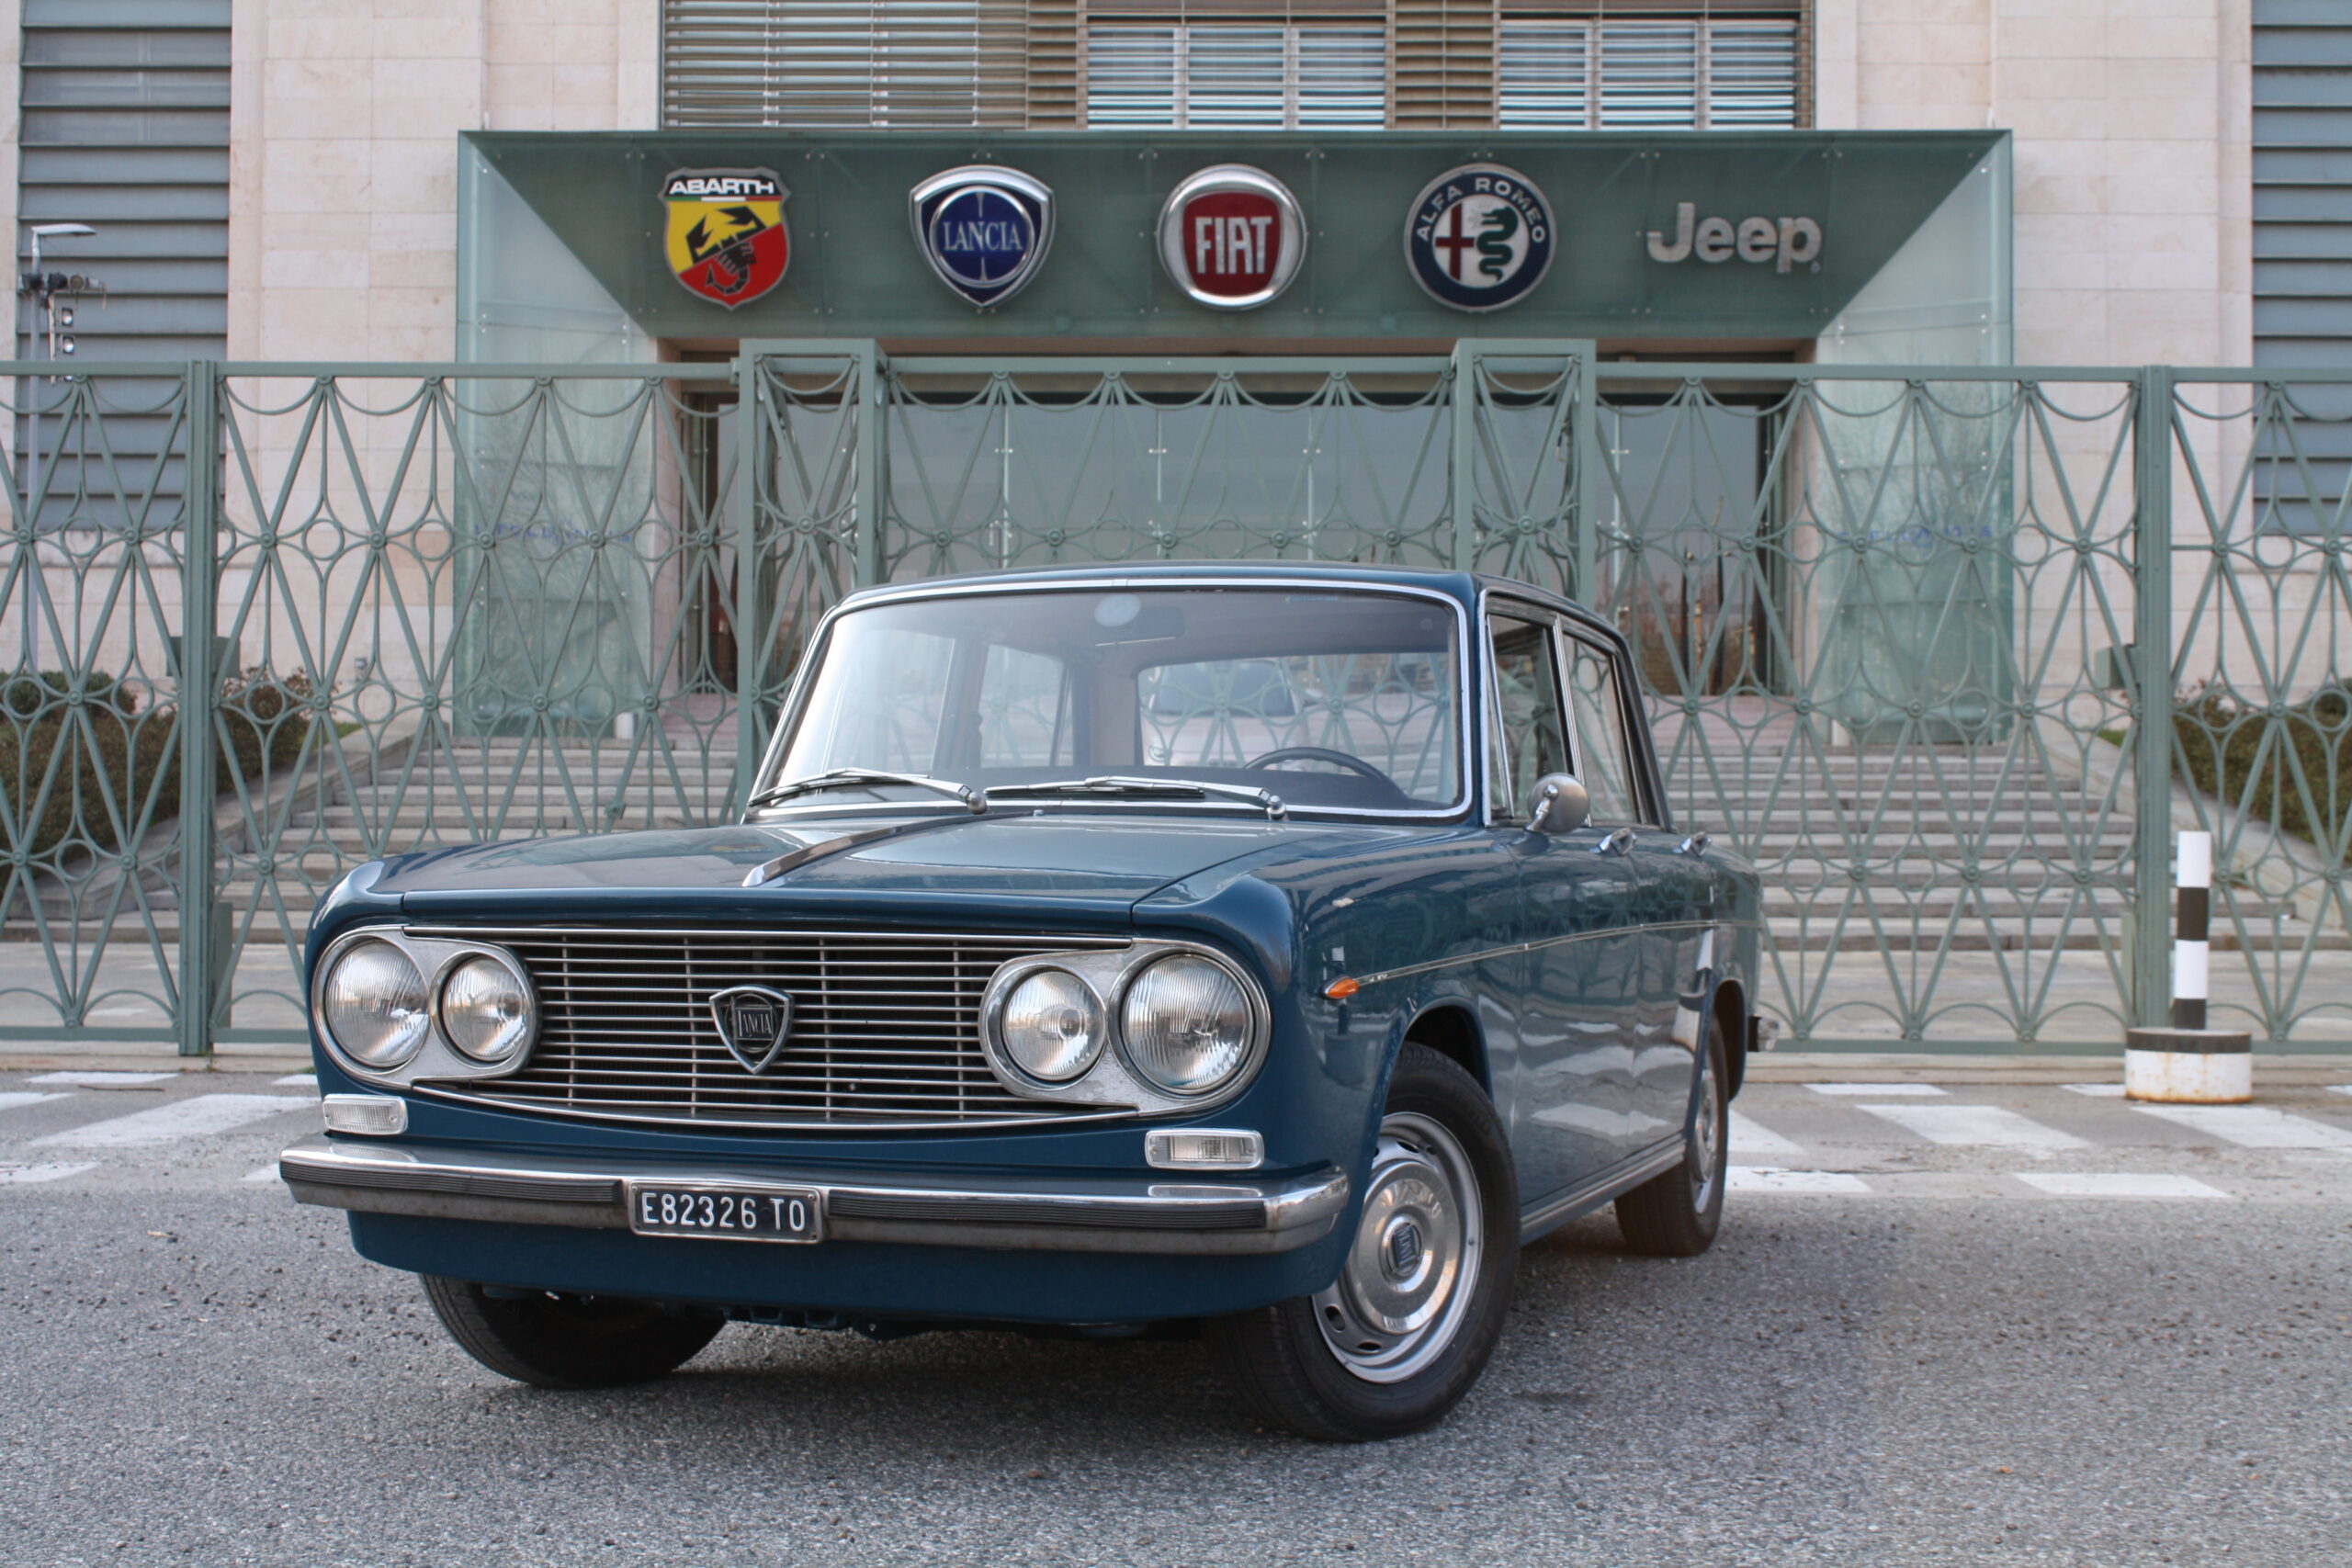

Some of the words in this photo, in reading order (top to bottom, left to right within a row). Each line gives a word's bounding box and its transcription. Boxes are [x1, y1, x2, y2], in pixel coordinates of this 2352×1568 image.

[669, 178, 775, 195] ABARTH
[1416, 185, 1463, 242] ALFA
[1475, 177, 1545, 243] ROMEO
[943, 220, 1023, 252] LANCIA
[1195, 217, 1272, 274] FIAT
[1646, 201, 1822, 273] Jeep
[642, 1192, 757, 1229] E82326
[769, 1198, 806, 1232] TO
